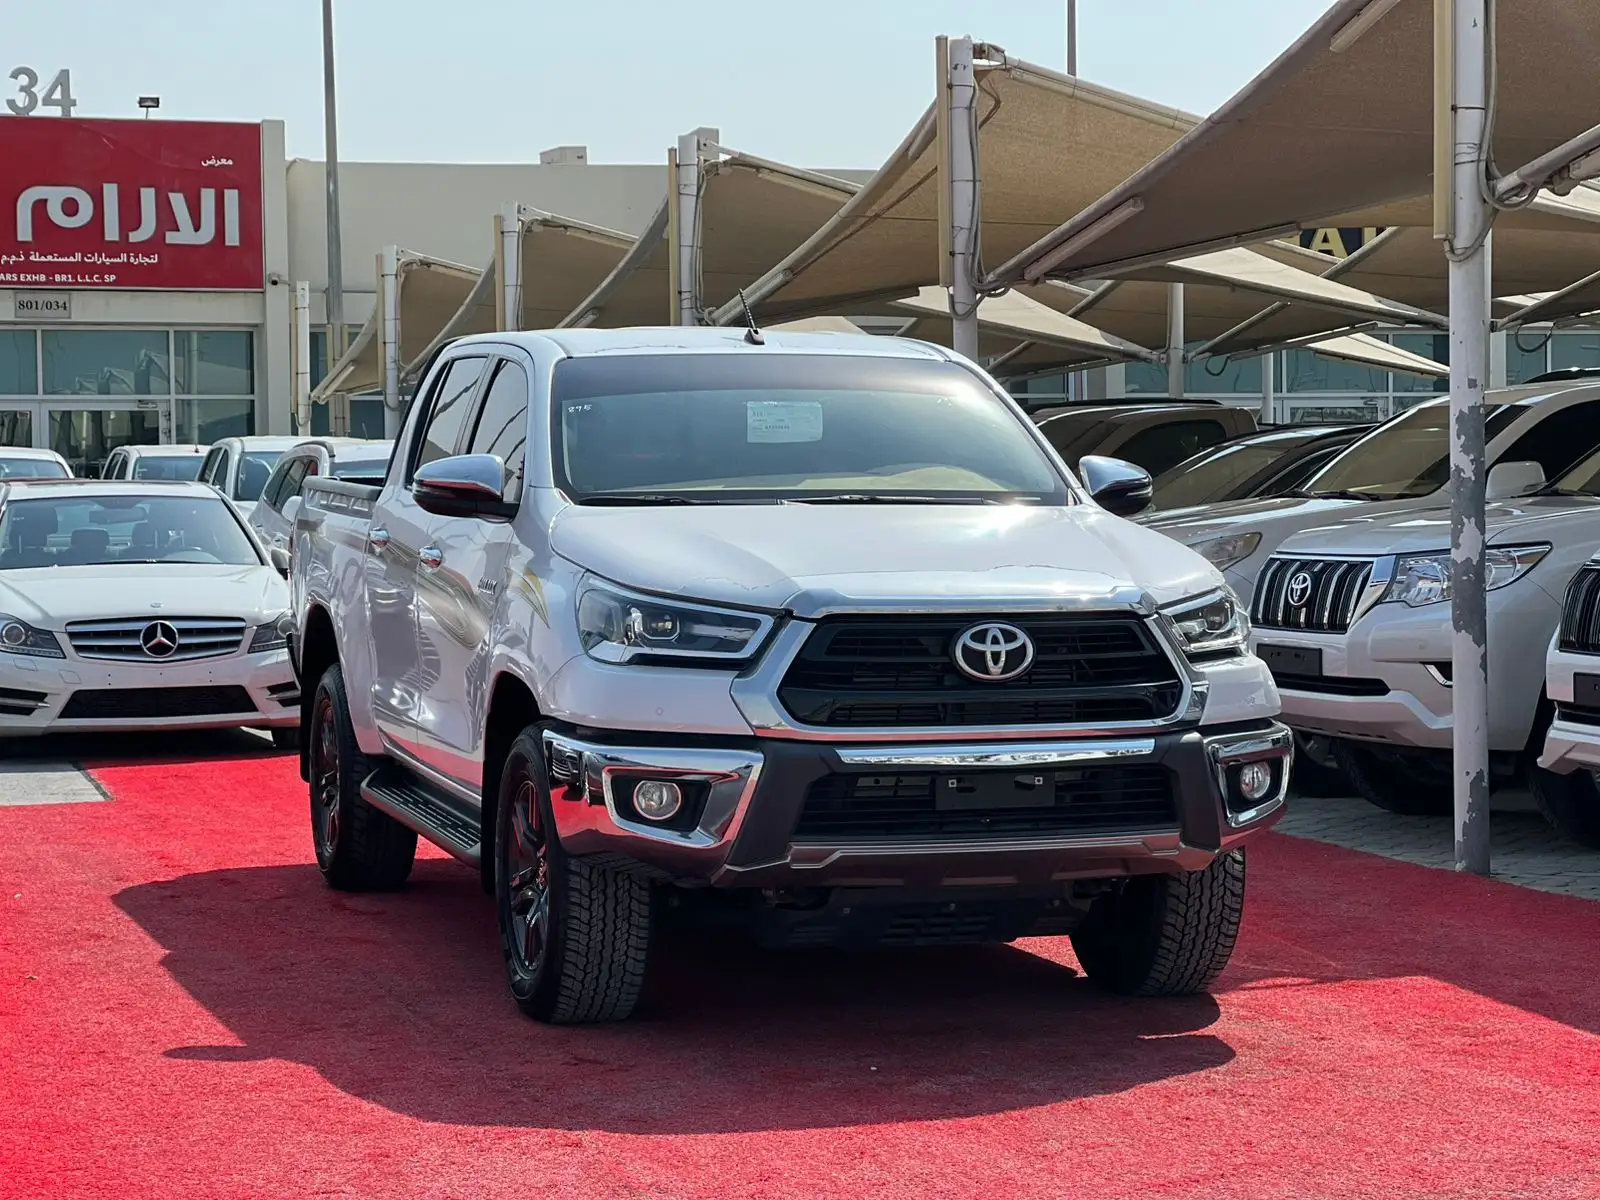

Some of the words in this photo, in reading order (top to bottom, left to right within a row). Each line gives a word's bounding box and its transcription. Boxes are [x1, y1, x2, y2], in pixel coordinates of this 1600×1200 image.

[6, 66, 77, 117] 34
[201, 155, 233, 167] معرض
[29, 251, 82, 263] المستعملة
[84, 253, 127, 265] السيارات
[129, 253, 158, 265] لتجارة
[20, 273, 46, 282] EXHB
[104, 274, 117, 283] SP
[18, 300, 67, 311] 801/034
